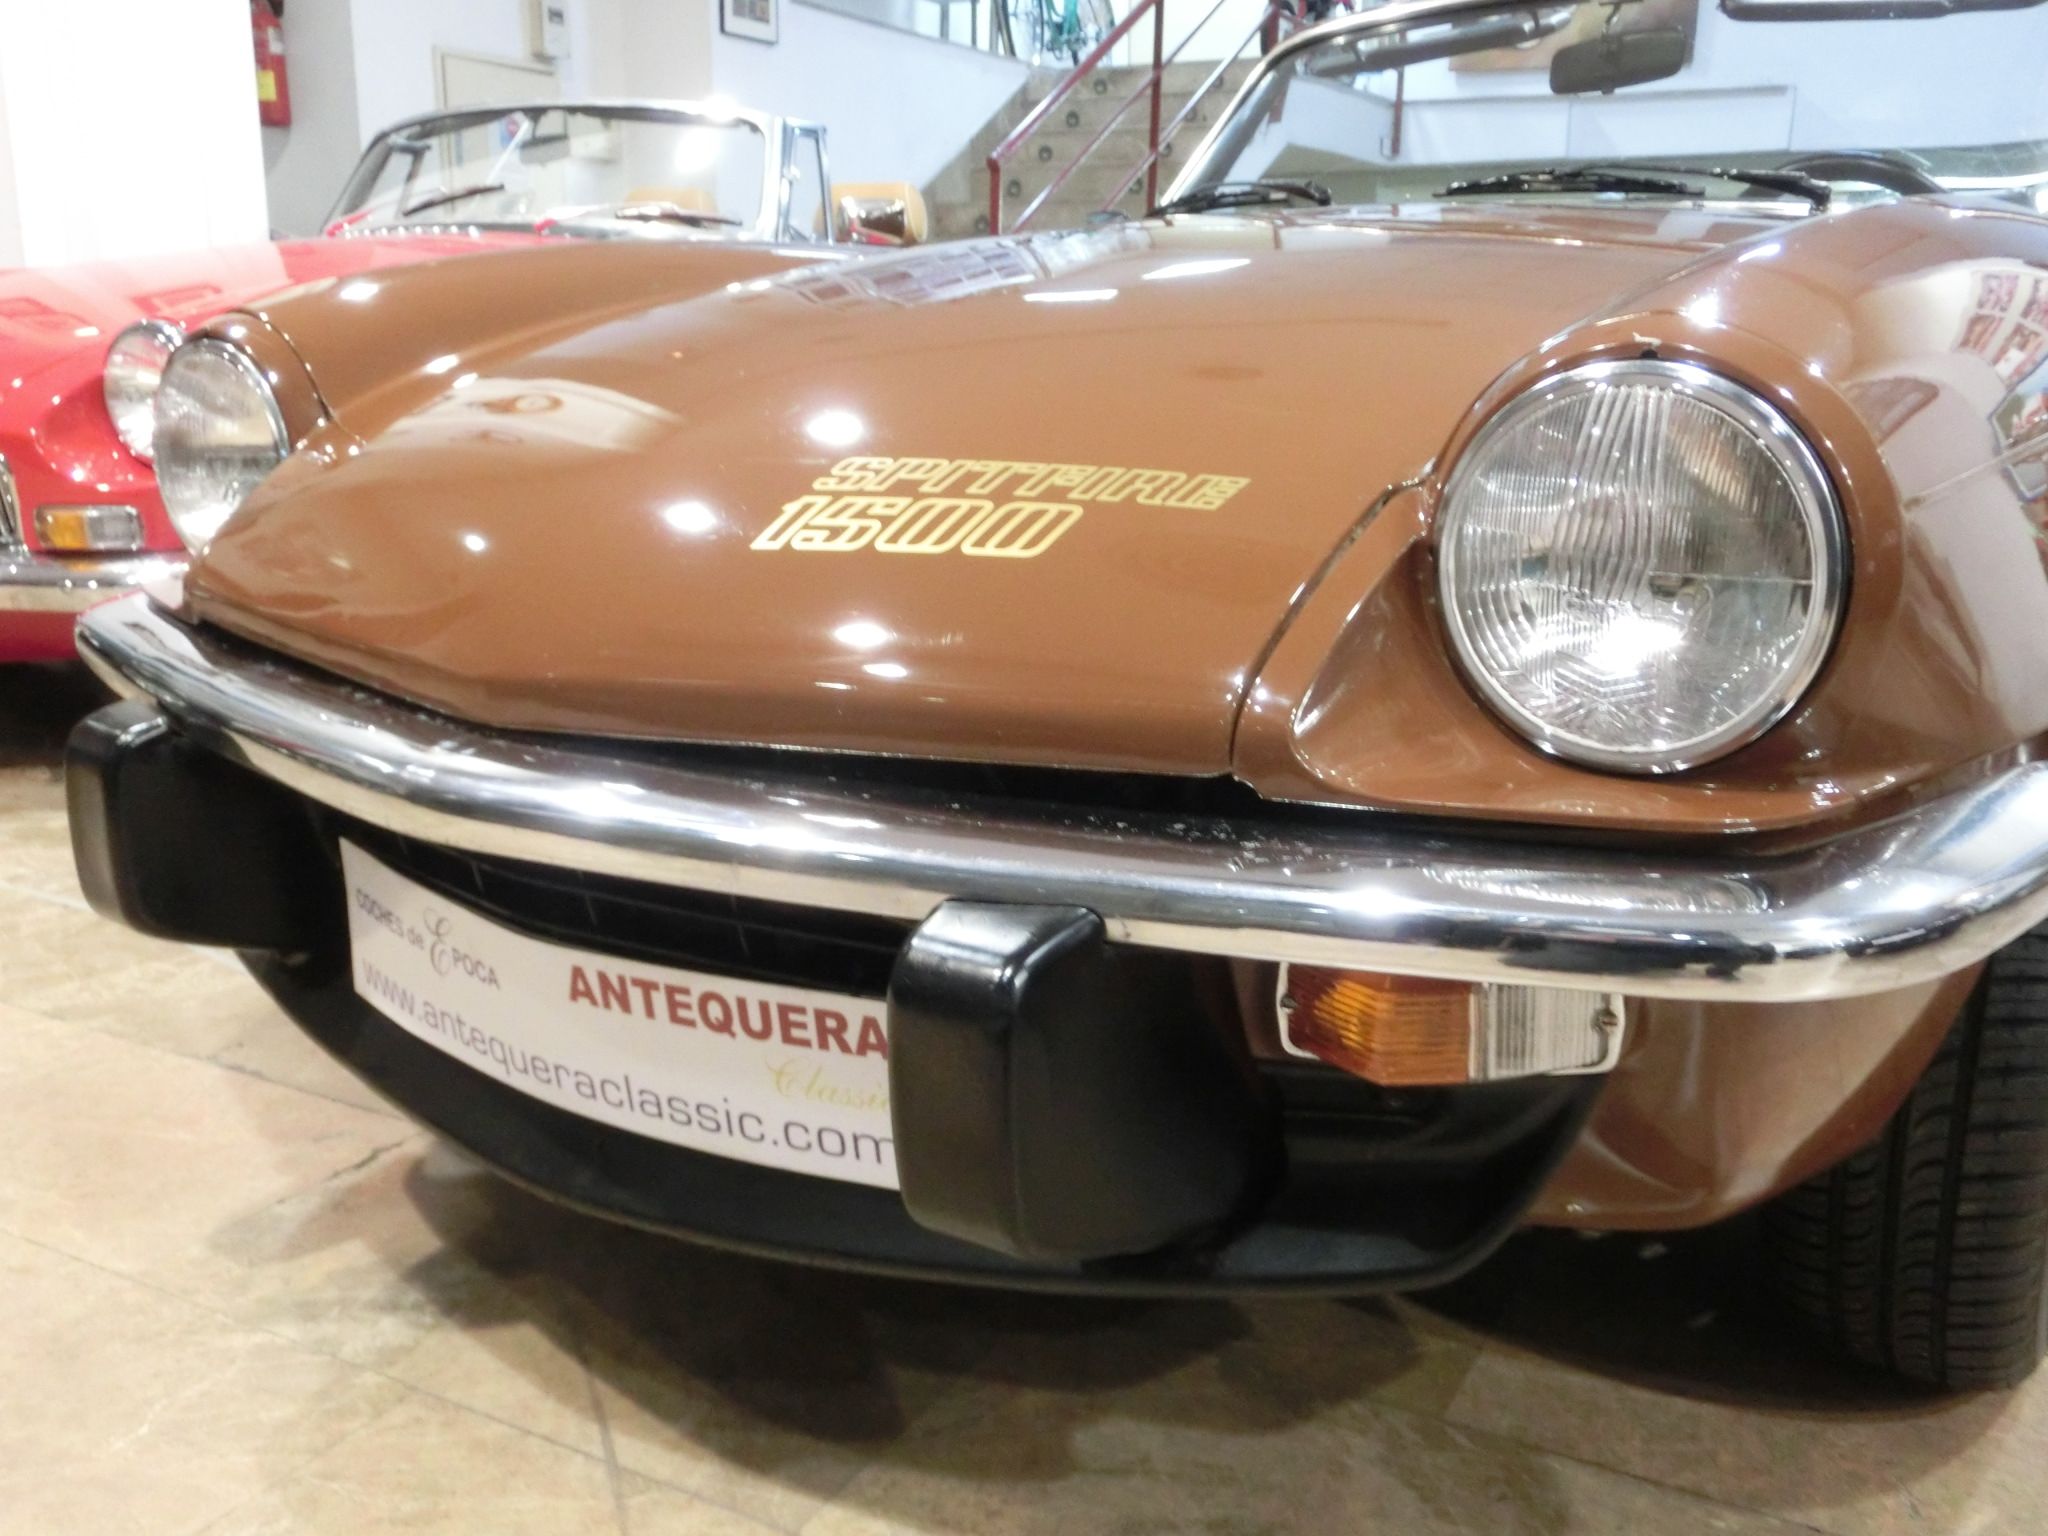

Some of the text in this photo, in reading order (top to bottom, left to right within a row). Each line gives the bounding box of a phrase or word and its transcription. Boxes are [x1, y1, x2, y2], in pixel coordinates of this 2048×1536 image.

[812, 456, 1251, 510] SPITFIRE
[750, 495, 1084, 558] 1500
[568, 964, 888, 1060] ANTEQUERA
[362, 958, 894, 1164] www.antequeraclassic.com
[764, 1053, 889, 1111] Classi
